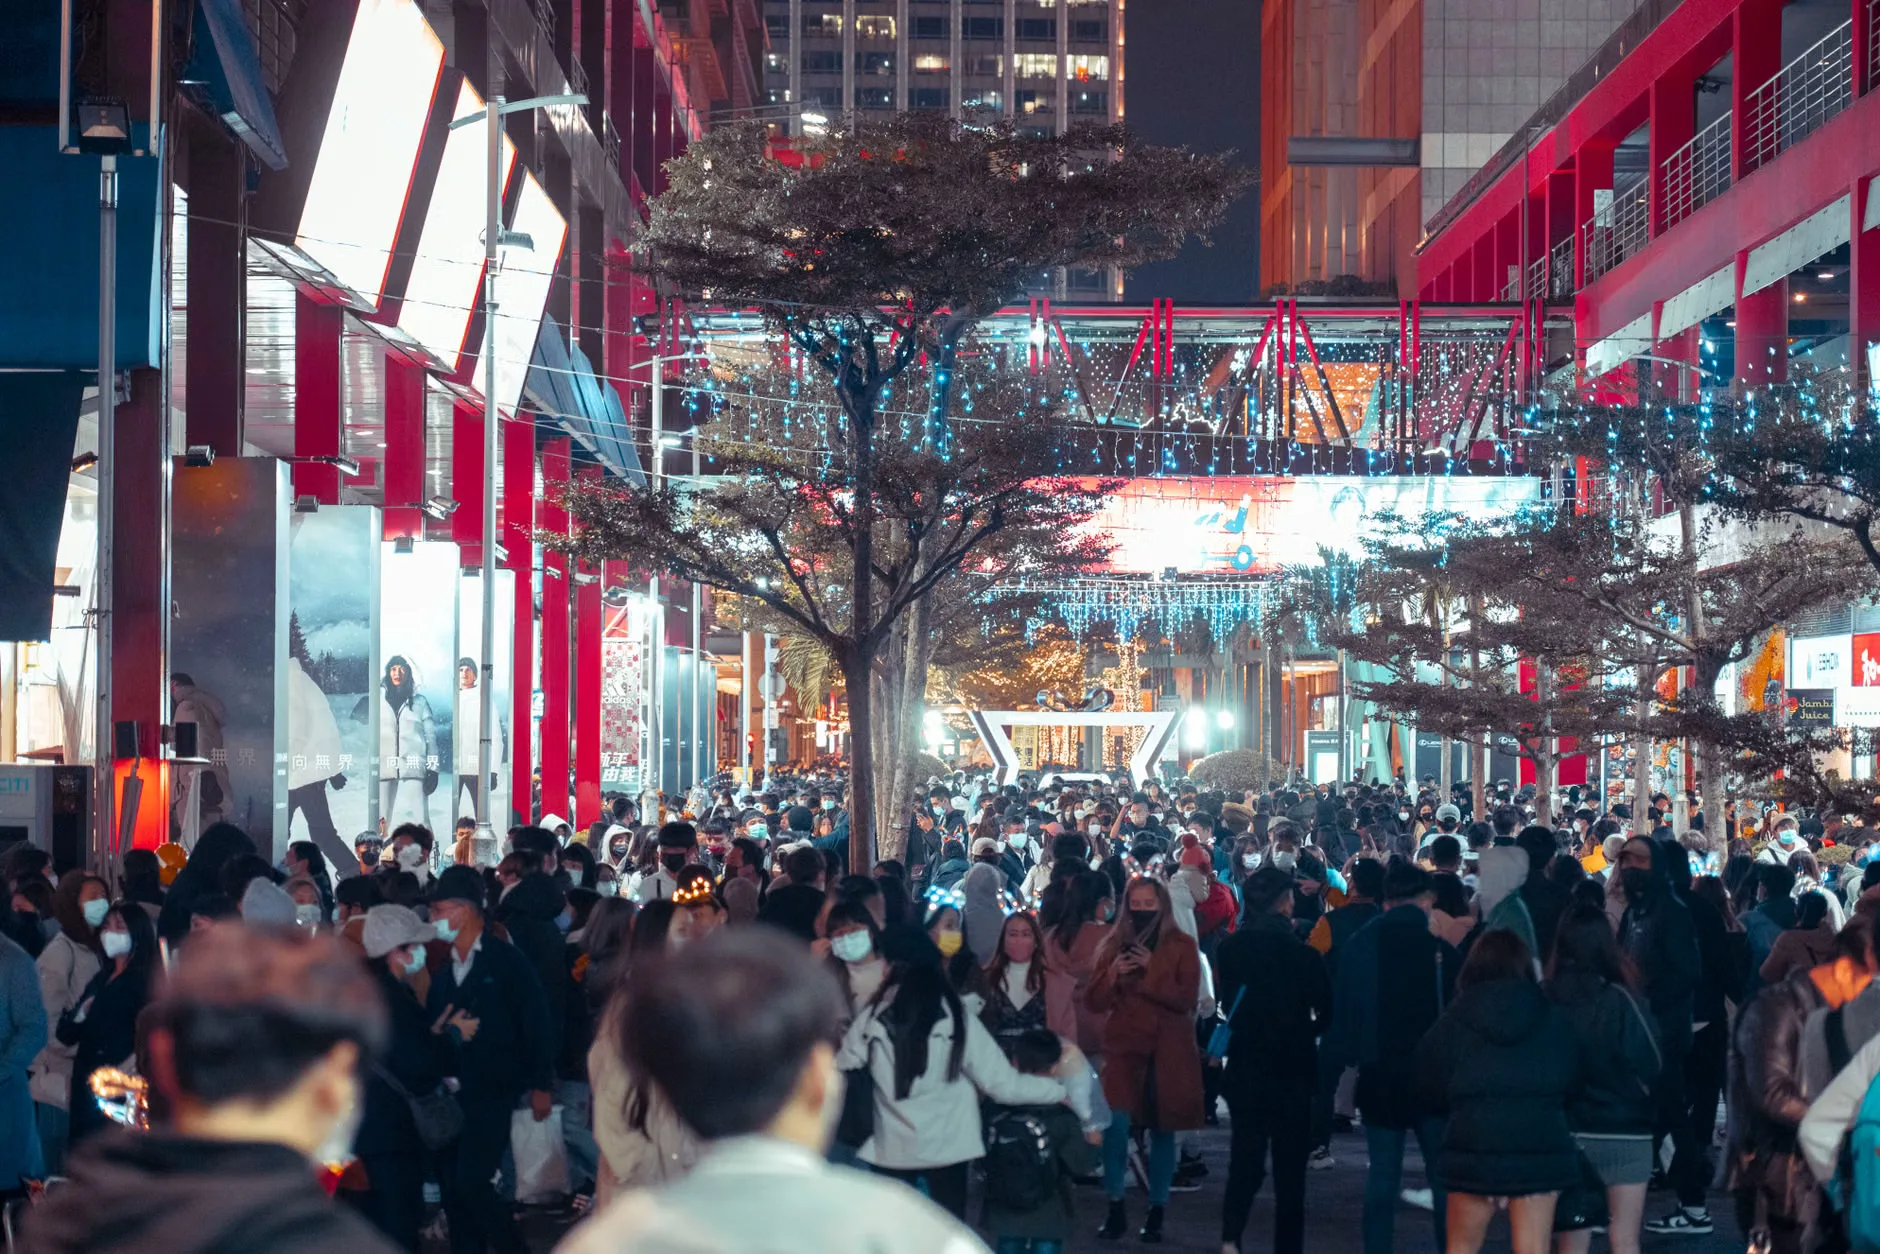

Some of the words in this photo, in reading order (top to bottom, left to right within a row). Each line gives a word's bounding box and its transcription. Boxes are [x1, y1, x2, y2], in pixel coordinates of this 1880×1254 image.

[292, 753, 353, 771] 向無界
[386, 755, 439, 771] 向無界
